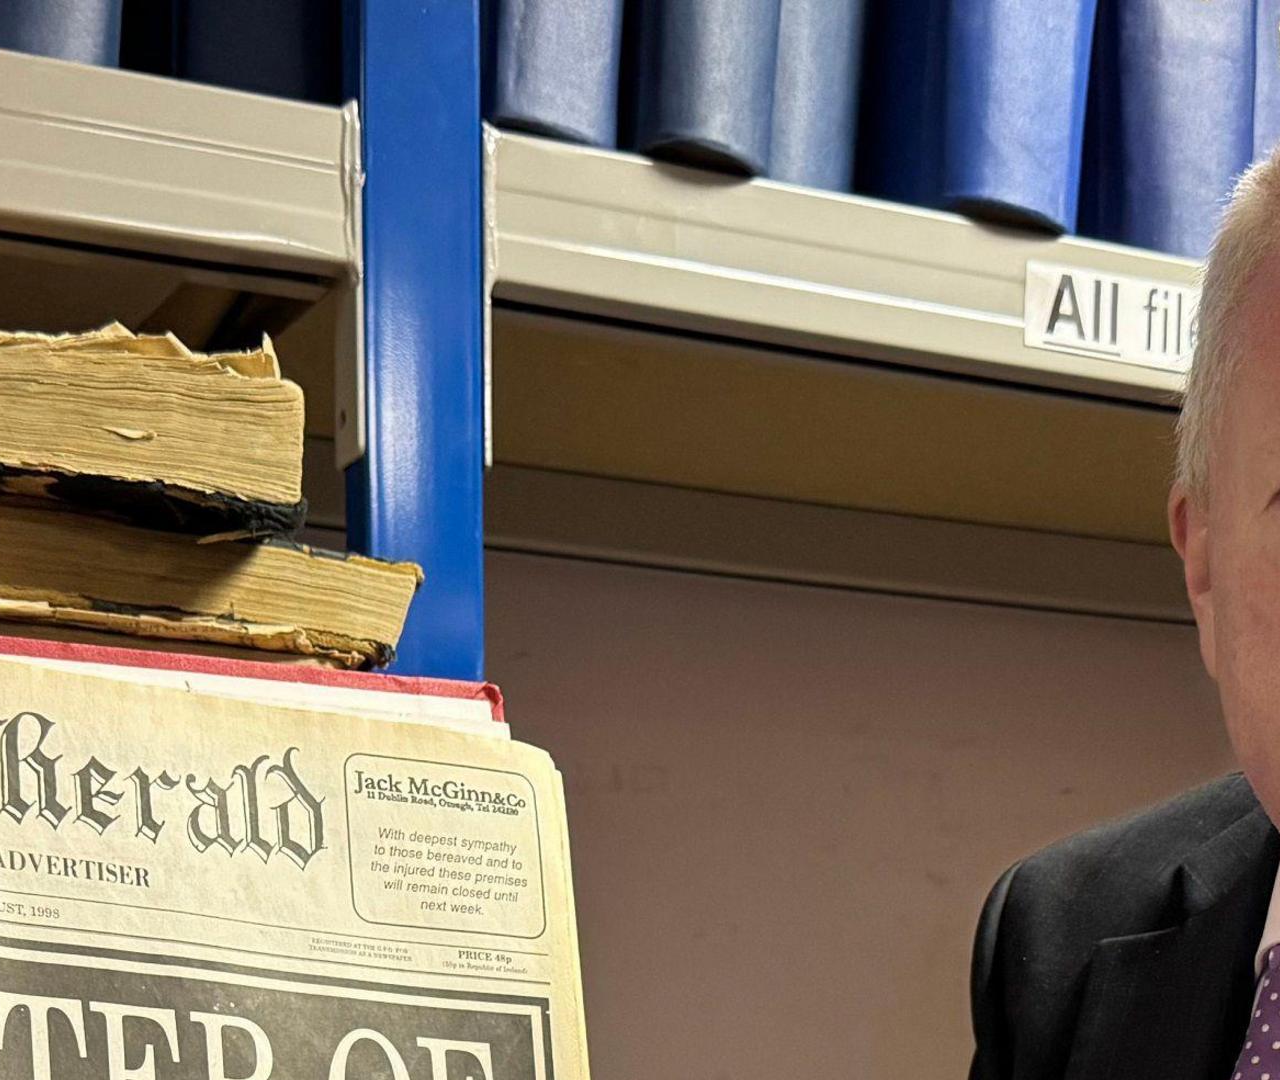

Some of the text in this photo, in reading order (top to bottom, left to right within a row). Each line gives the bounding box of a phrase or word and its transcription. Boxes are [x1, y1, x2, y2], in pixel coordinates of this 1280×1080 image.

[1046, 274, 1119, 345] All
[354, 771, 402, 794] Jack
[378, 826, 517, 856] With deepest sympathy
[420, 900, 483, 915] next week.
[458, 949, 492, 961] PRICE
